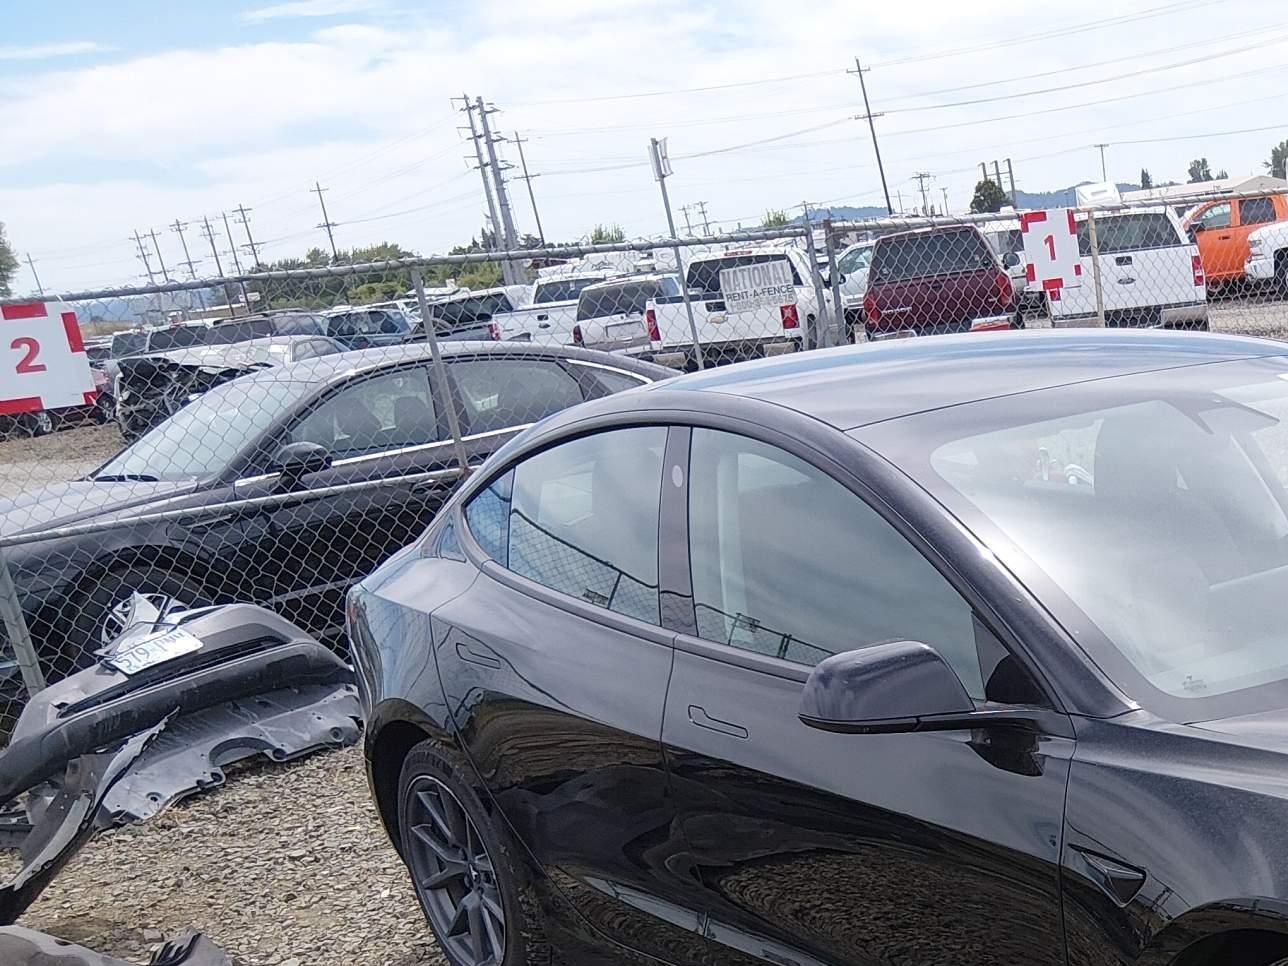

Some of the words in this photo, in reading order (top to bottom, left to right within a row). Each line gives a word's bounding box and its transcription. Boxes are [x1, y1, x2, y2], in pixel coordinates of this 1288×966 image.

[1043, 234, 1057, 261] 1
[720, 262, 792, 293] NATIONAL
[726, 284, 793, 302] RENT-A-FENCE
[10, 336, 48, 374] 2
